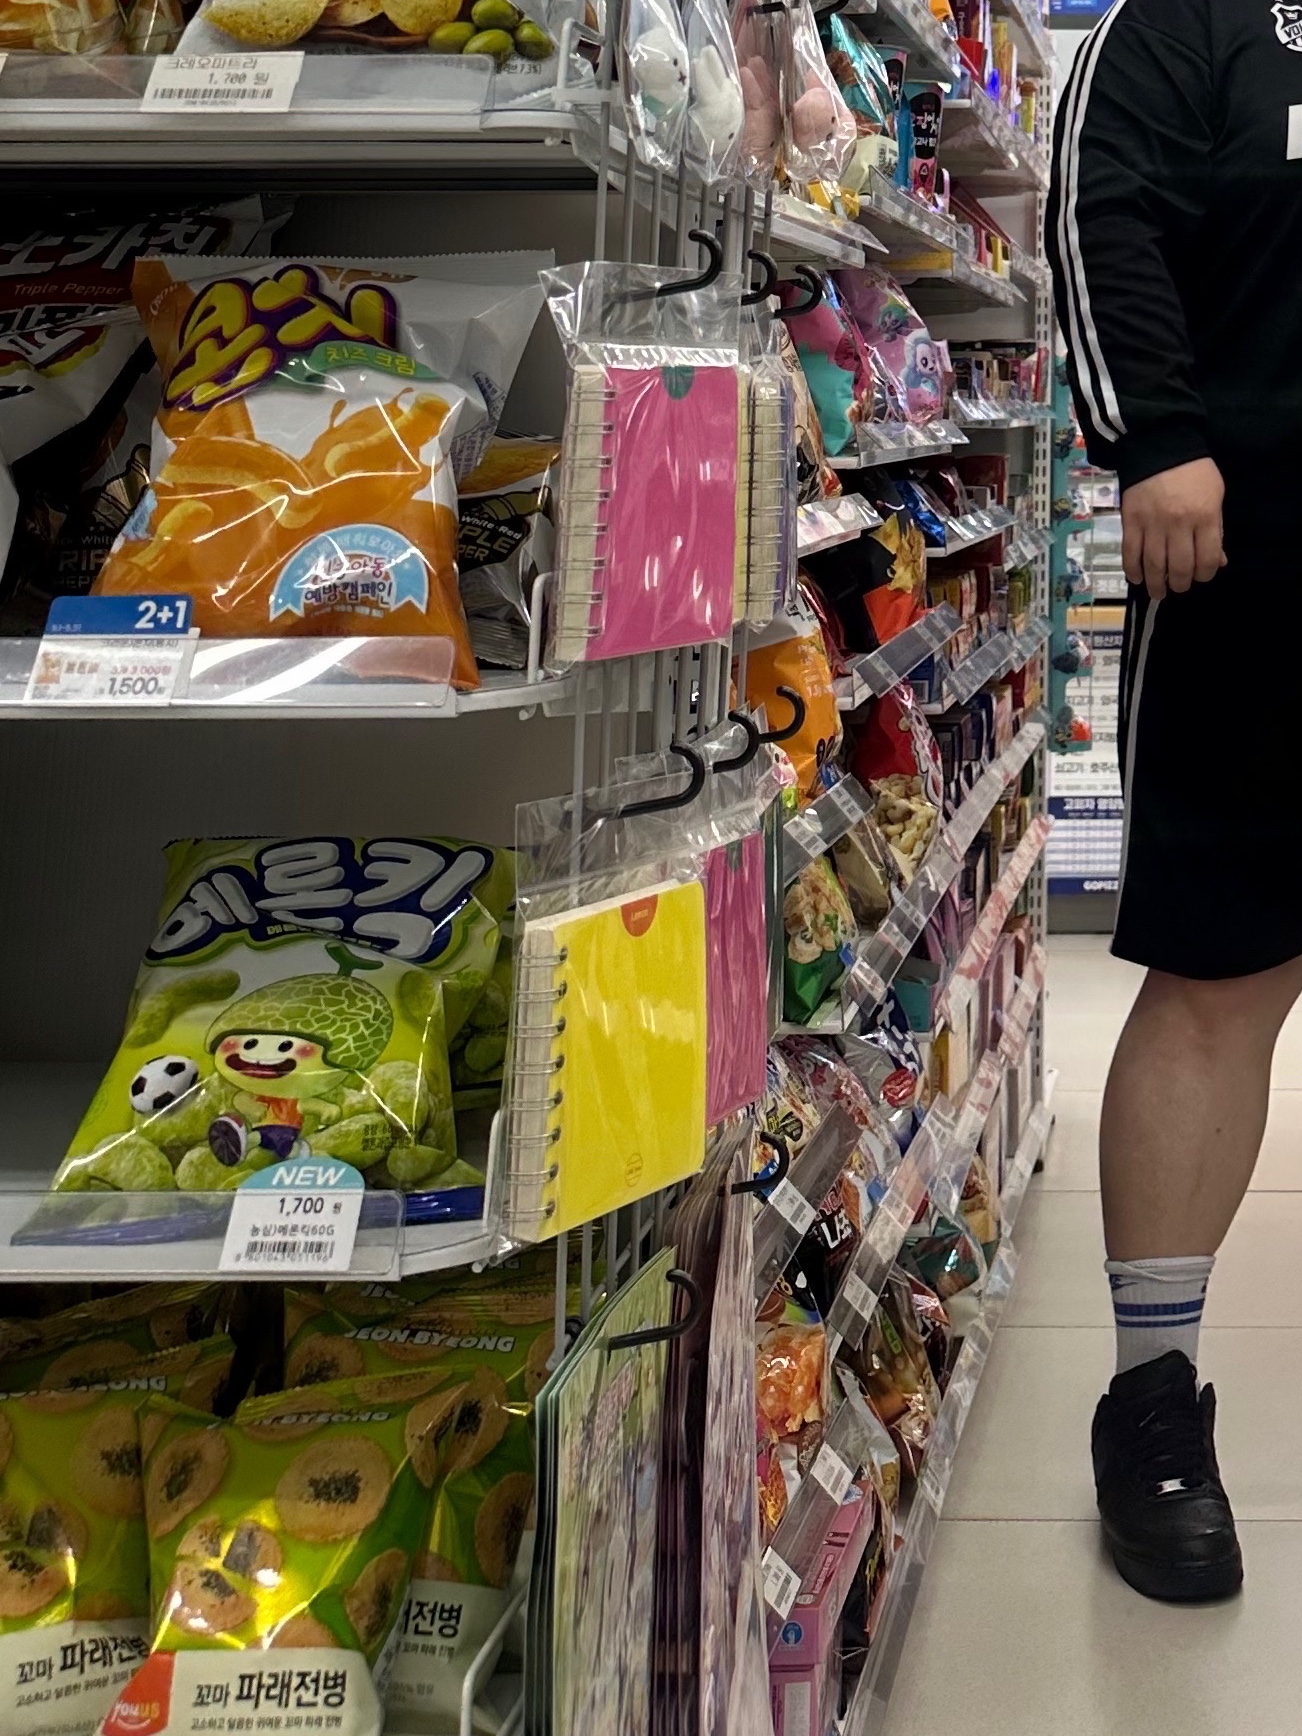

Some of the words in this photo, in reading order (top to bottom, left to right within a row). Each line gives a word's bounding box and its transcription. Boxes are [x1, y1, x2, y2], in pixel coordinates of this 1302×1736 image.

[14, 282, 58, 297] Triple
[62, 281, 125, 298] Pepper
[326, 345, 370, 361] 치즈
[375, 352, 416, 375] 크림
[135, 600, 188, 630] 2+1
[108, 677, 159, 697] 1,500
[147, 839, 493, 963] 메론킥
[271, 1166, 347, 1186] NEW
[278, 1197, 325, 1217] 1,700
[403, 1598, 463, 1639] 전병
[17, 1657, 53, 1686] 꼬마
[193, 1683, 231, 1707] 꼬마
[235, 1669, 347, 1710] 파래전병
